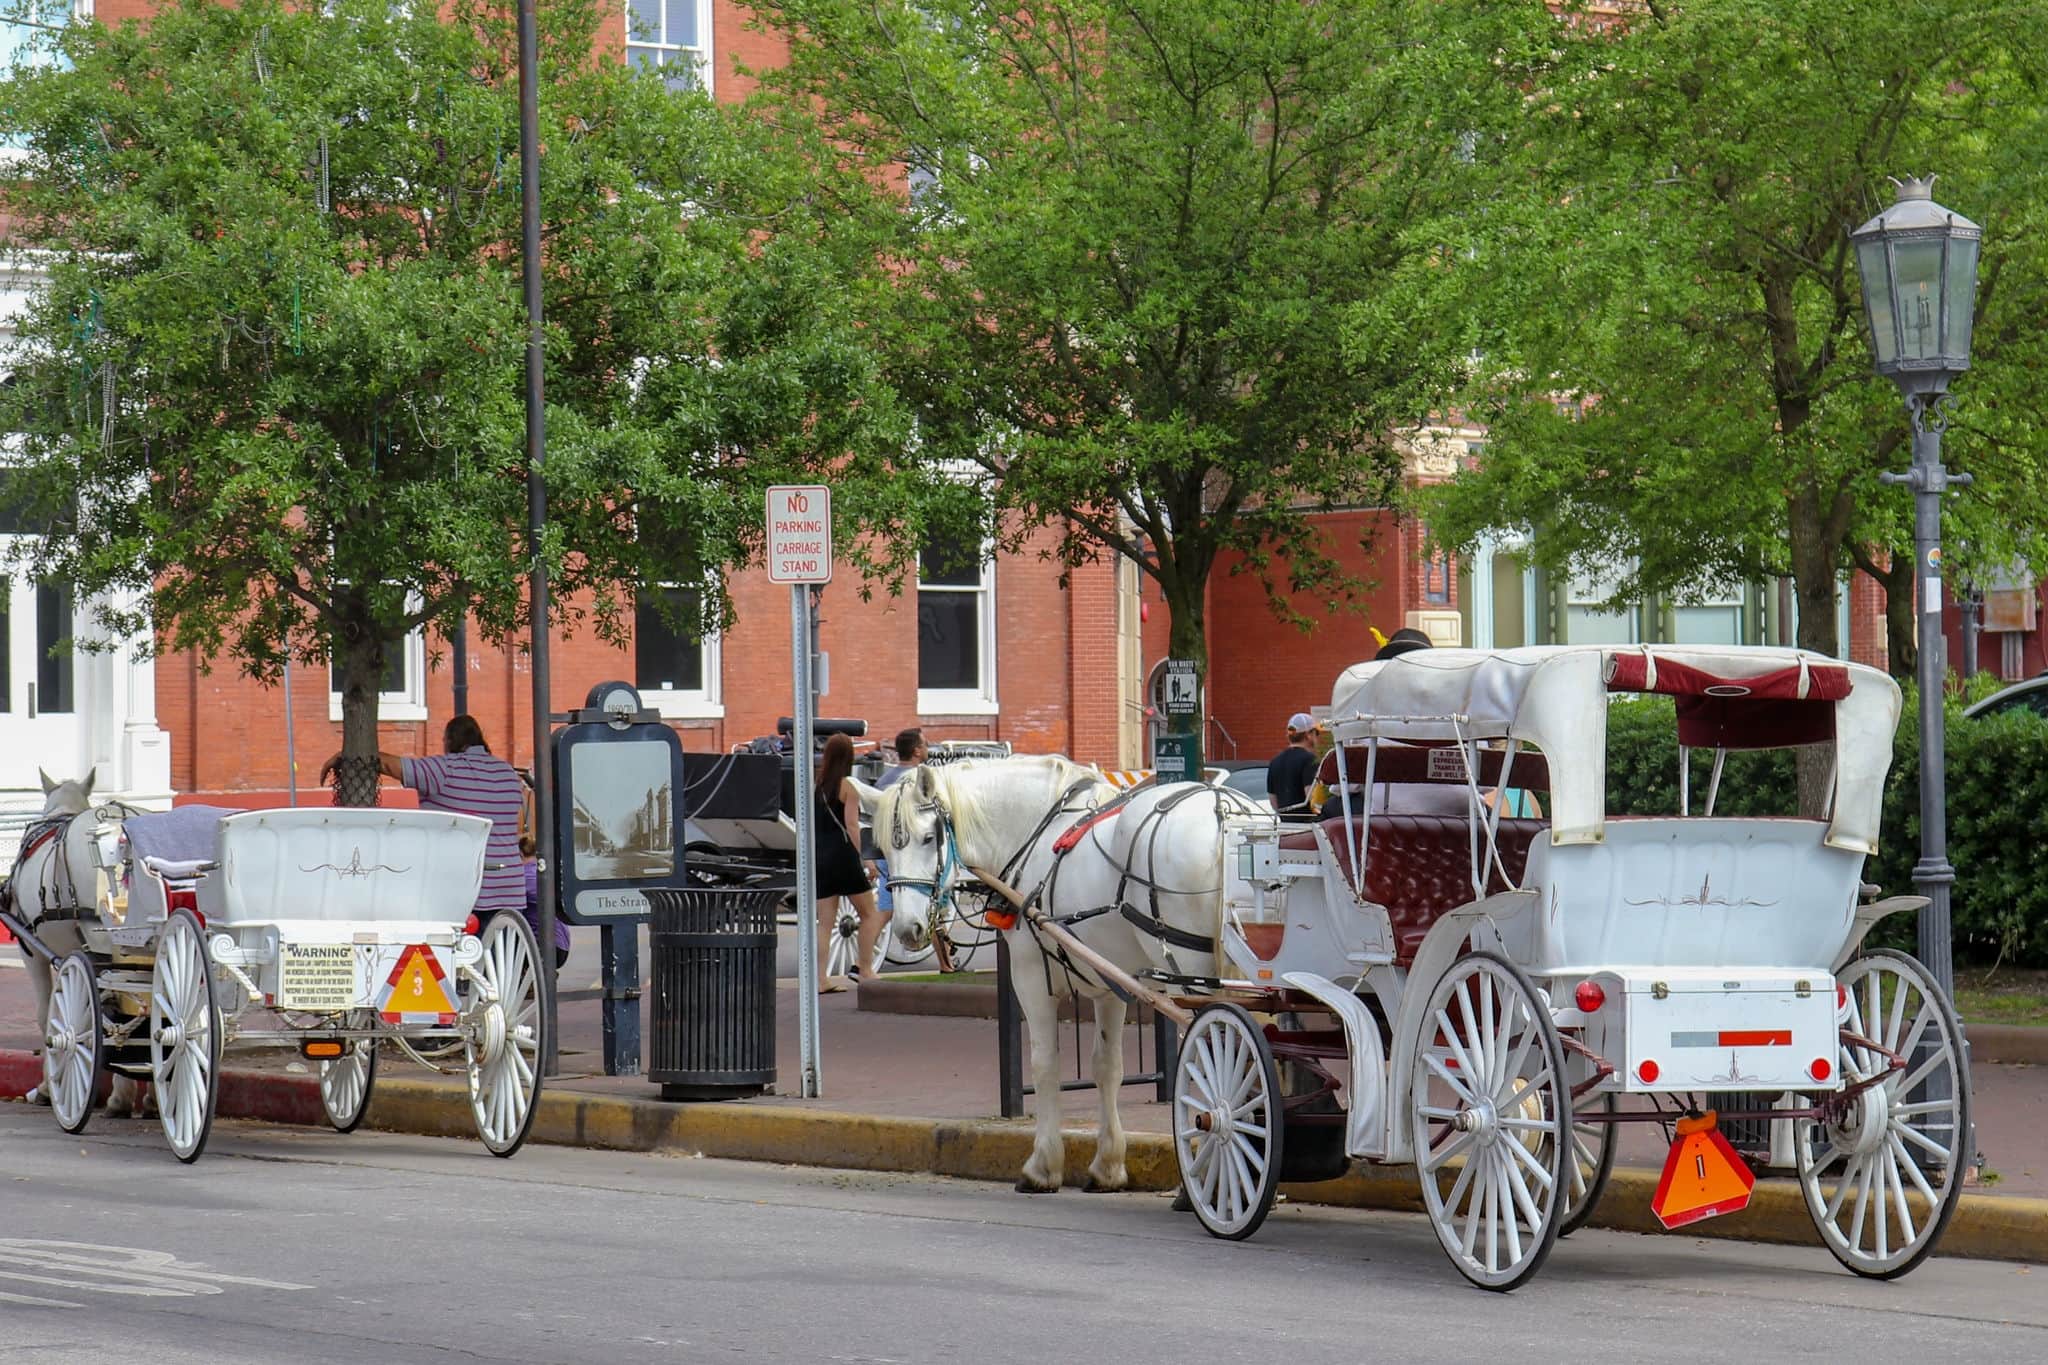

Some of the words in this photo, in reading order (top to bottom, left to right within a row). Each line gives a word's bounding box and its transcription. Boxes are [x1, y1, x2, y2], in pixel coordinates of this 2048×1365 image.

[787, 496, 809, 513] NO
[775, 521, 822, 533] PARKING
[776, 542, 822, 555] CARRIAGE
[782, 560, 818, 573] STAND
[596, 896, 618, 908] The
[620, 896, 648, 907] Stran
[291, 947, 349, 958] WARNING
[413, 976, 424, 996] 3
[1696, 1154, 1706, 1179] 1
